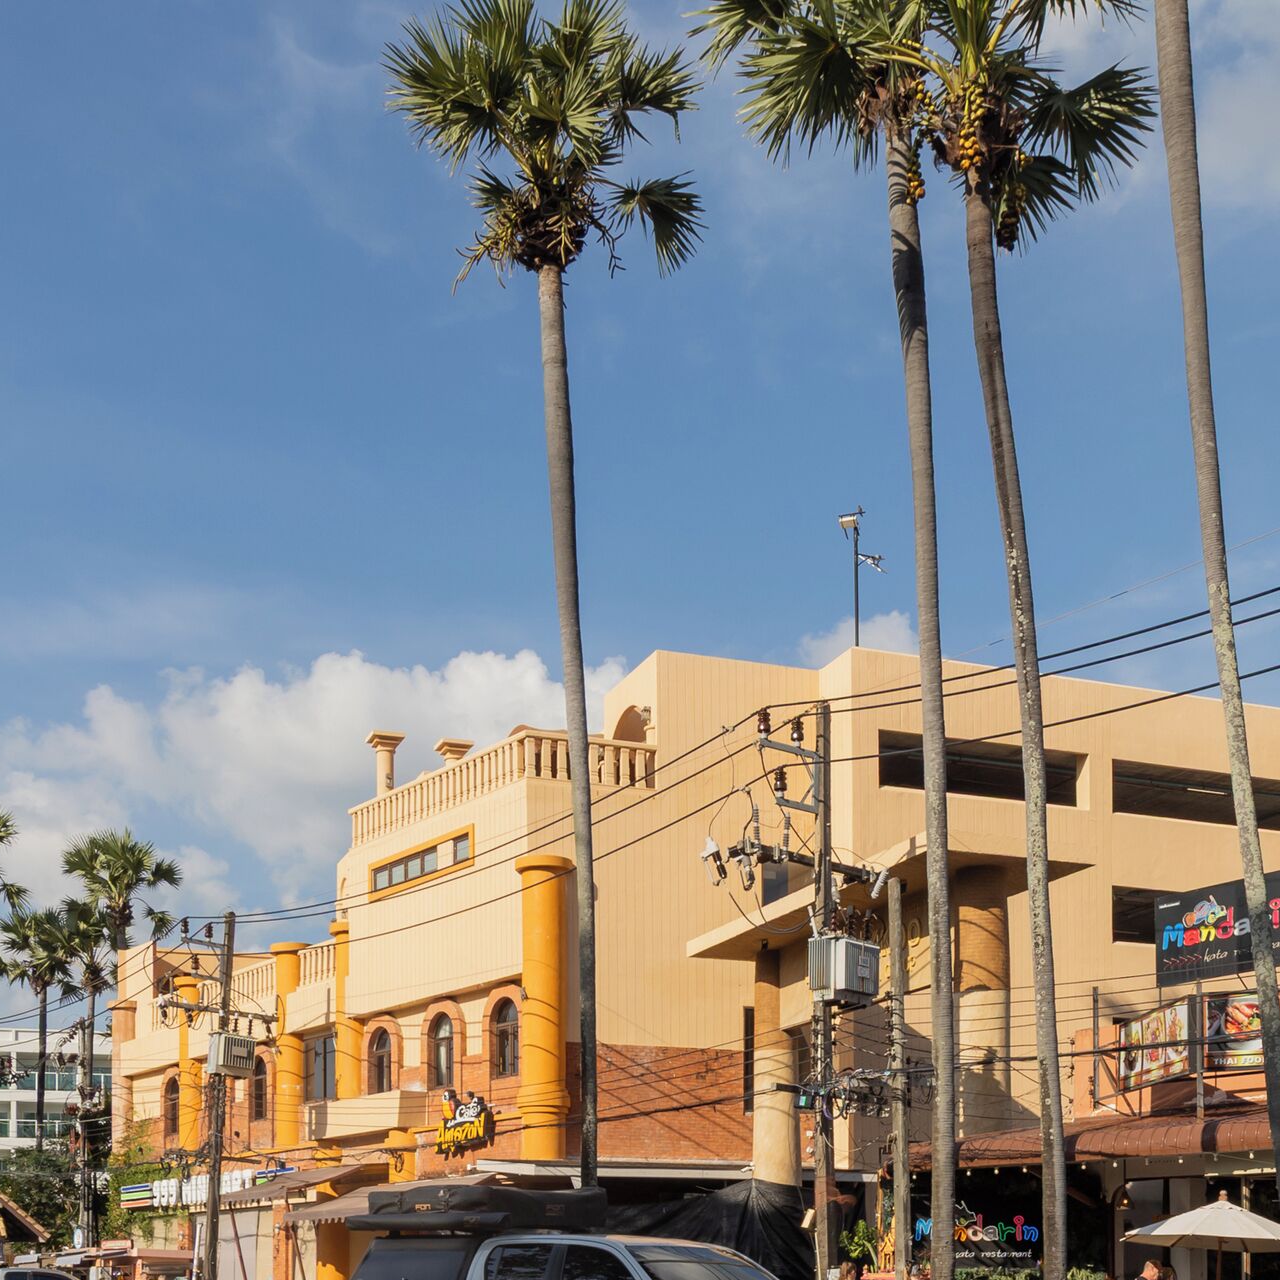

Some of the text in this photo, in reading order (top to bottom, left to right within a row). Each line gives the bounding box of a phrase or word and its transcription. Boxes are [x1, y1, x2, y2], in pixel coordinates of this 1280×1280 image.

[1213, 1056, 1265, 1066] THAI FOO
[915, 1213, 1039, 1242] Mndarin
